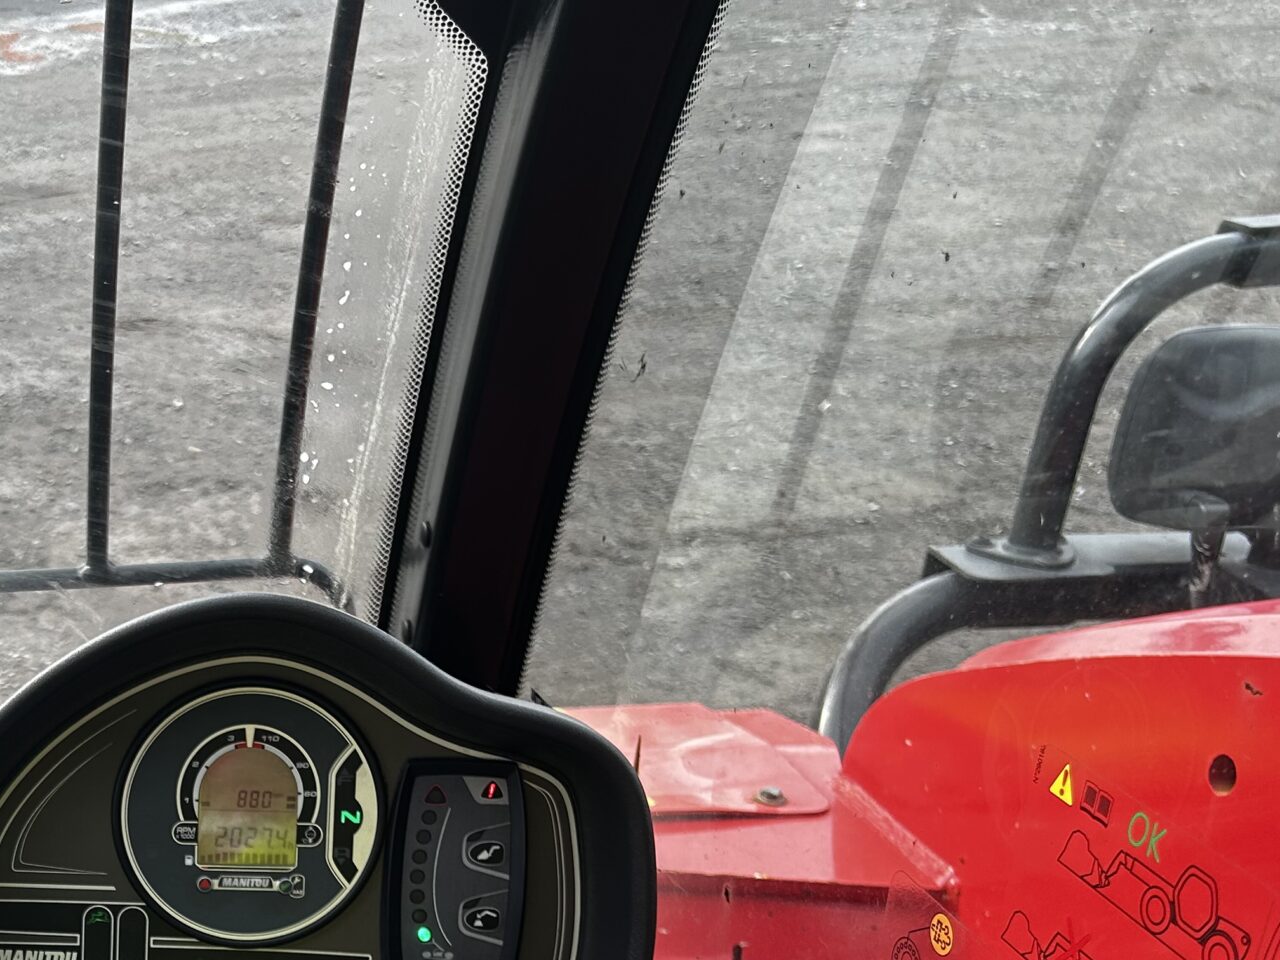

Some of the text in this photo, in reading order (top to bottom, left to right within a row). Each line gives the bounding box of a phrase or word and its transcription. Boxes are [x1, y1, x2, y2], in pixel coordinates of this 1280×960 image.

[236, 789, 273, 809] 880
[1128, 812, 1167, 863] OK
[222, 878, 270, 888] MANITOU
